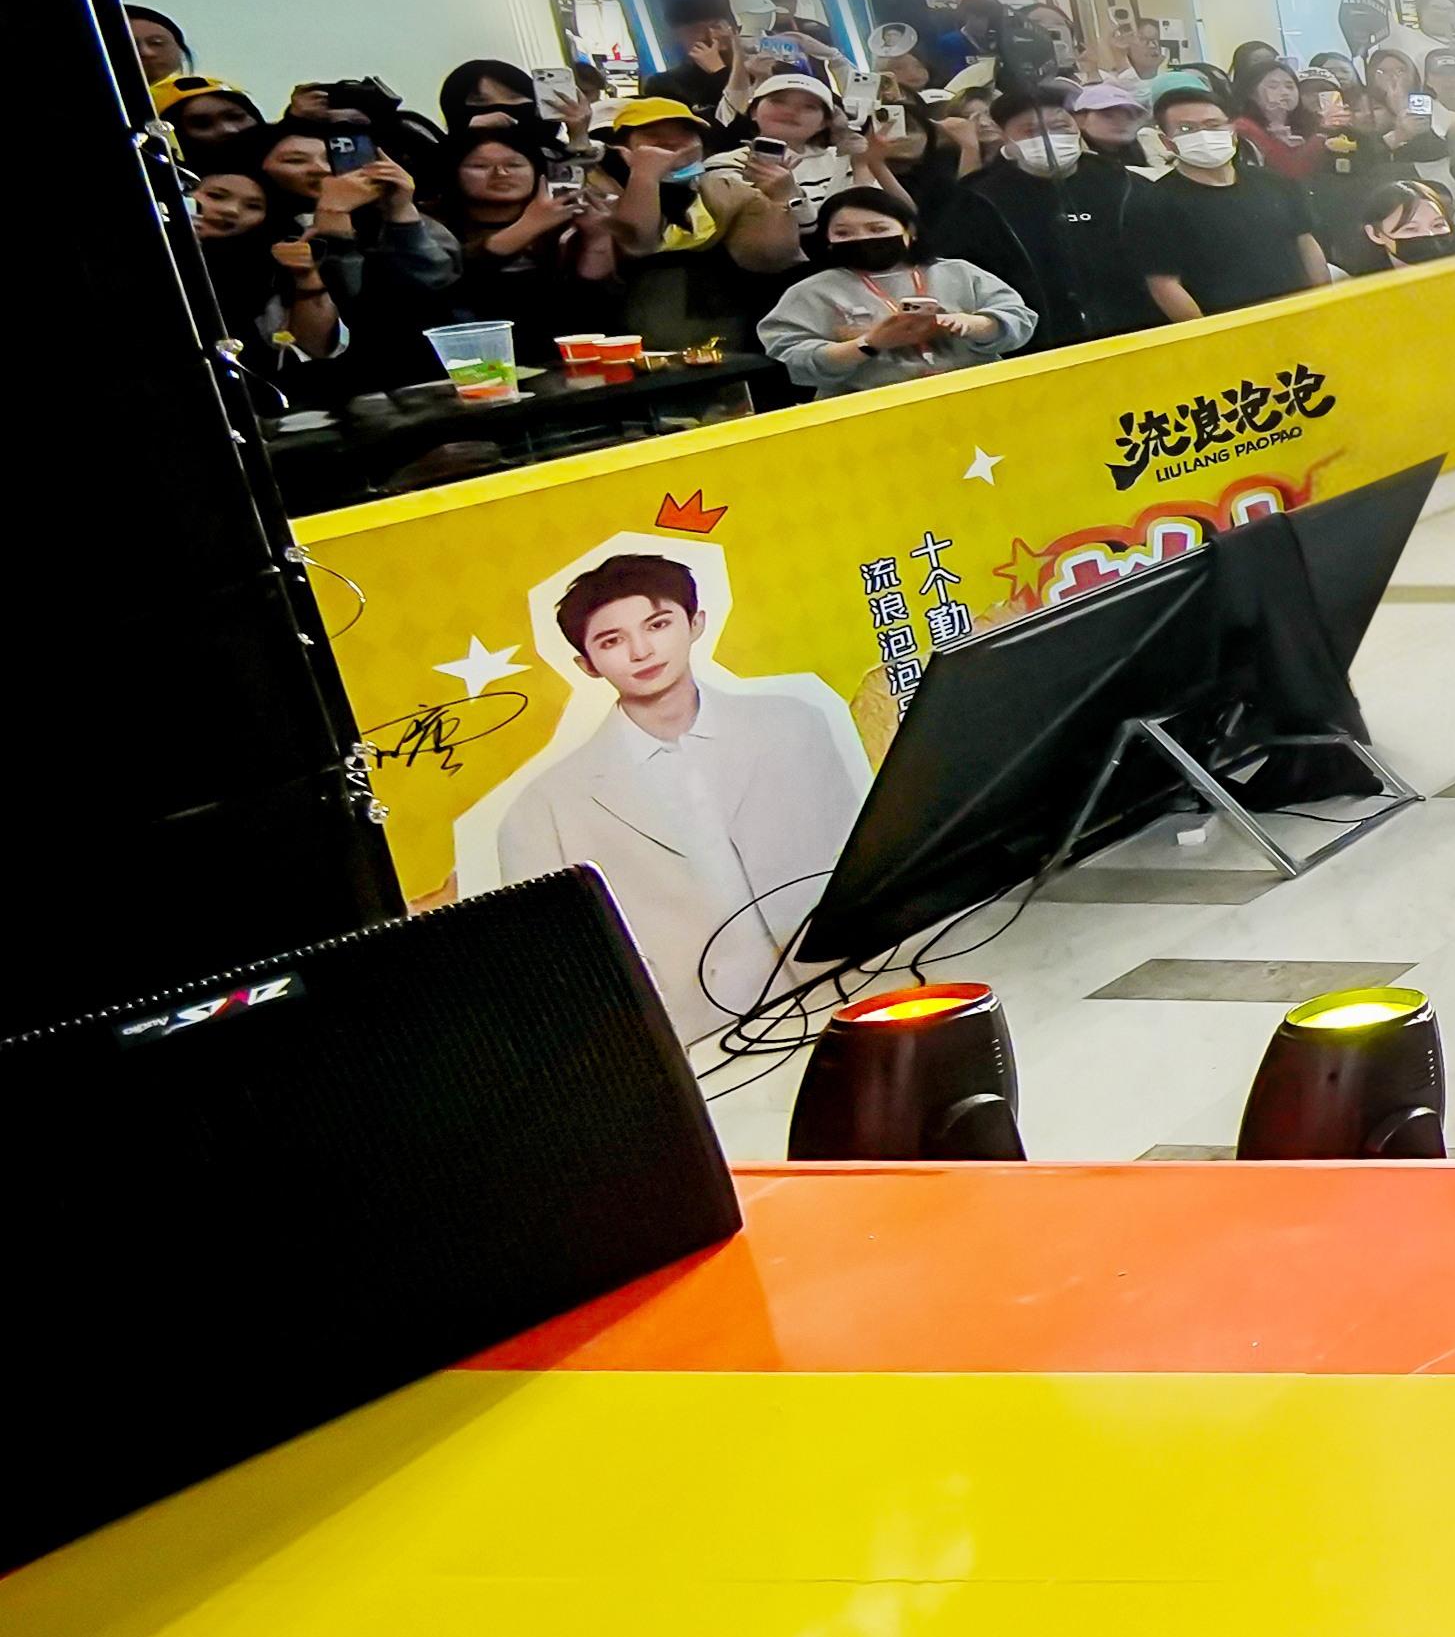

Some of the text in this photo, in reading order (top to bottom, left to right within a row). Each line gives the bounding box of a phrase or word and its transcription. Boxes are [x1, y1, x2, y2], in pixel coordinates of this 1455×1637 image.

[1106, 364, 1337, 491] 流浪泡泡
[1155, 426, 1303, 483] LIULANG PAOPAO
